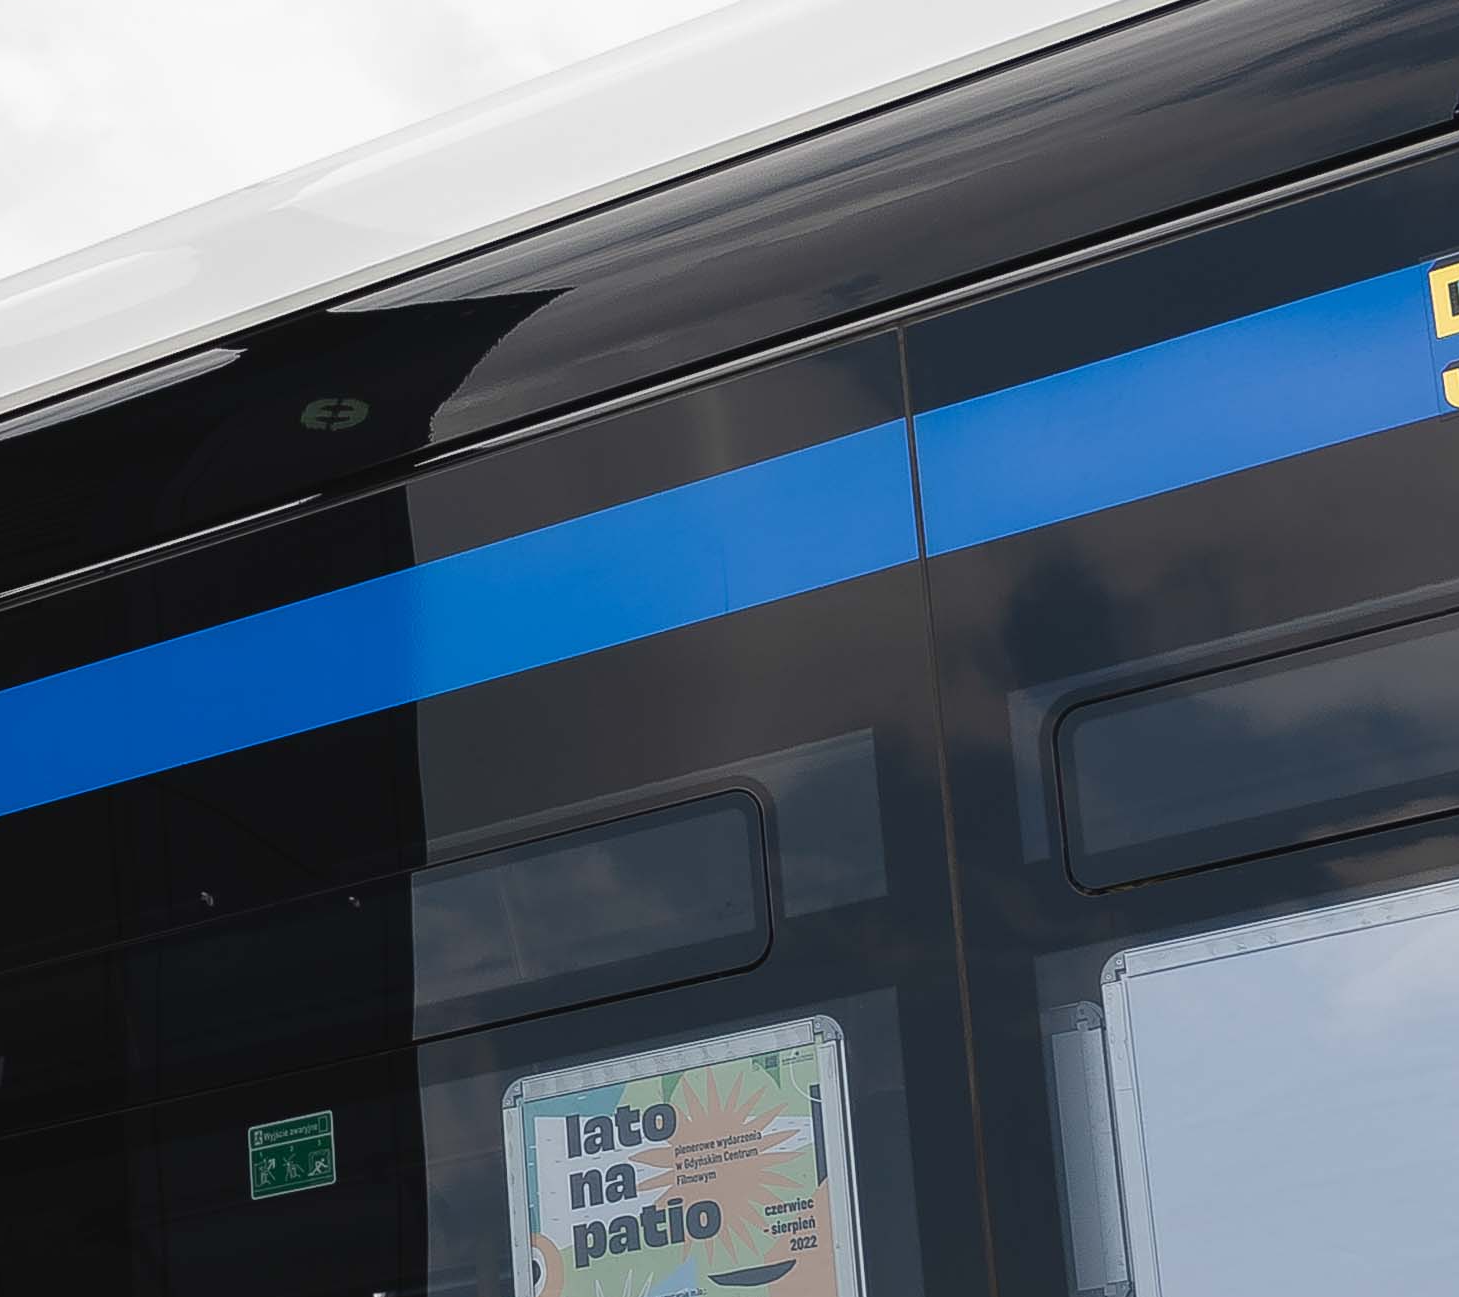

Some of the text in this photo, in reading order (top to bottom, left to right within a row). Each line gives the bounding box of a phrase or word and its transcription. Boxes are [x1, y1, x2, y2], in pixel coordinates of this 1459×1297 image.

[565, 1103, 677, 1159] lato
[674, 1130, 762, 1157] plenerowe wydarzenia
[676, 1147, 759, 1172] w Gdyńskim Centrum
[569, 1162, 637, 1210] na
[676, 1171, 717, 1187] Filmowym
[764, 1197, 814, 1217] czerwiec
[573, 1198, 722, 1269] patio
[771, 1217, 816, 1237] sierpień
[790, 1235, 818, 1252] 2022
